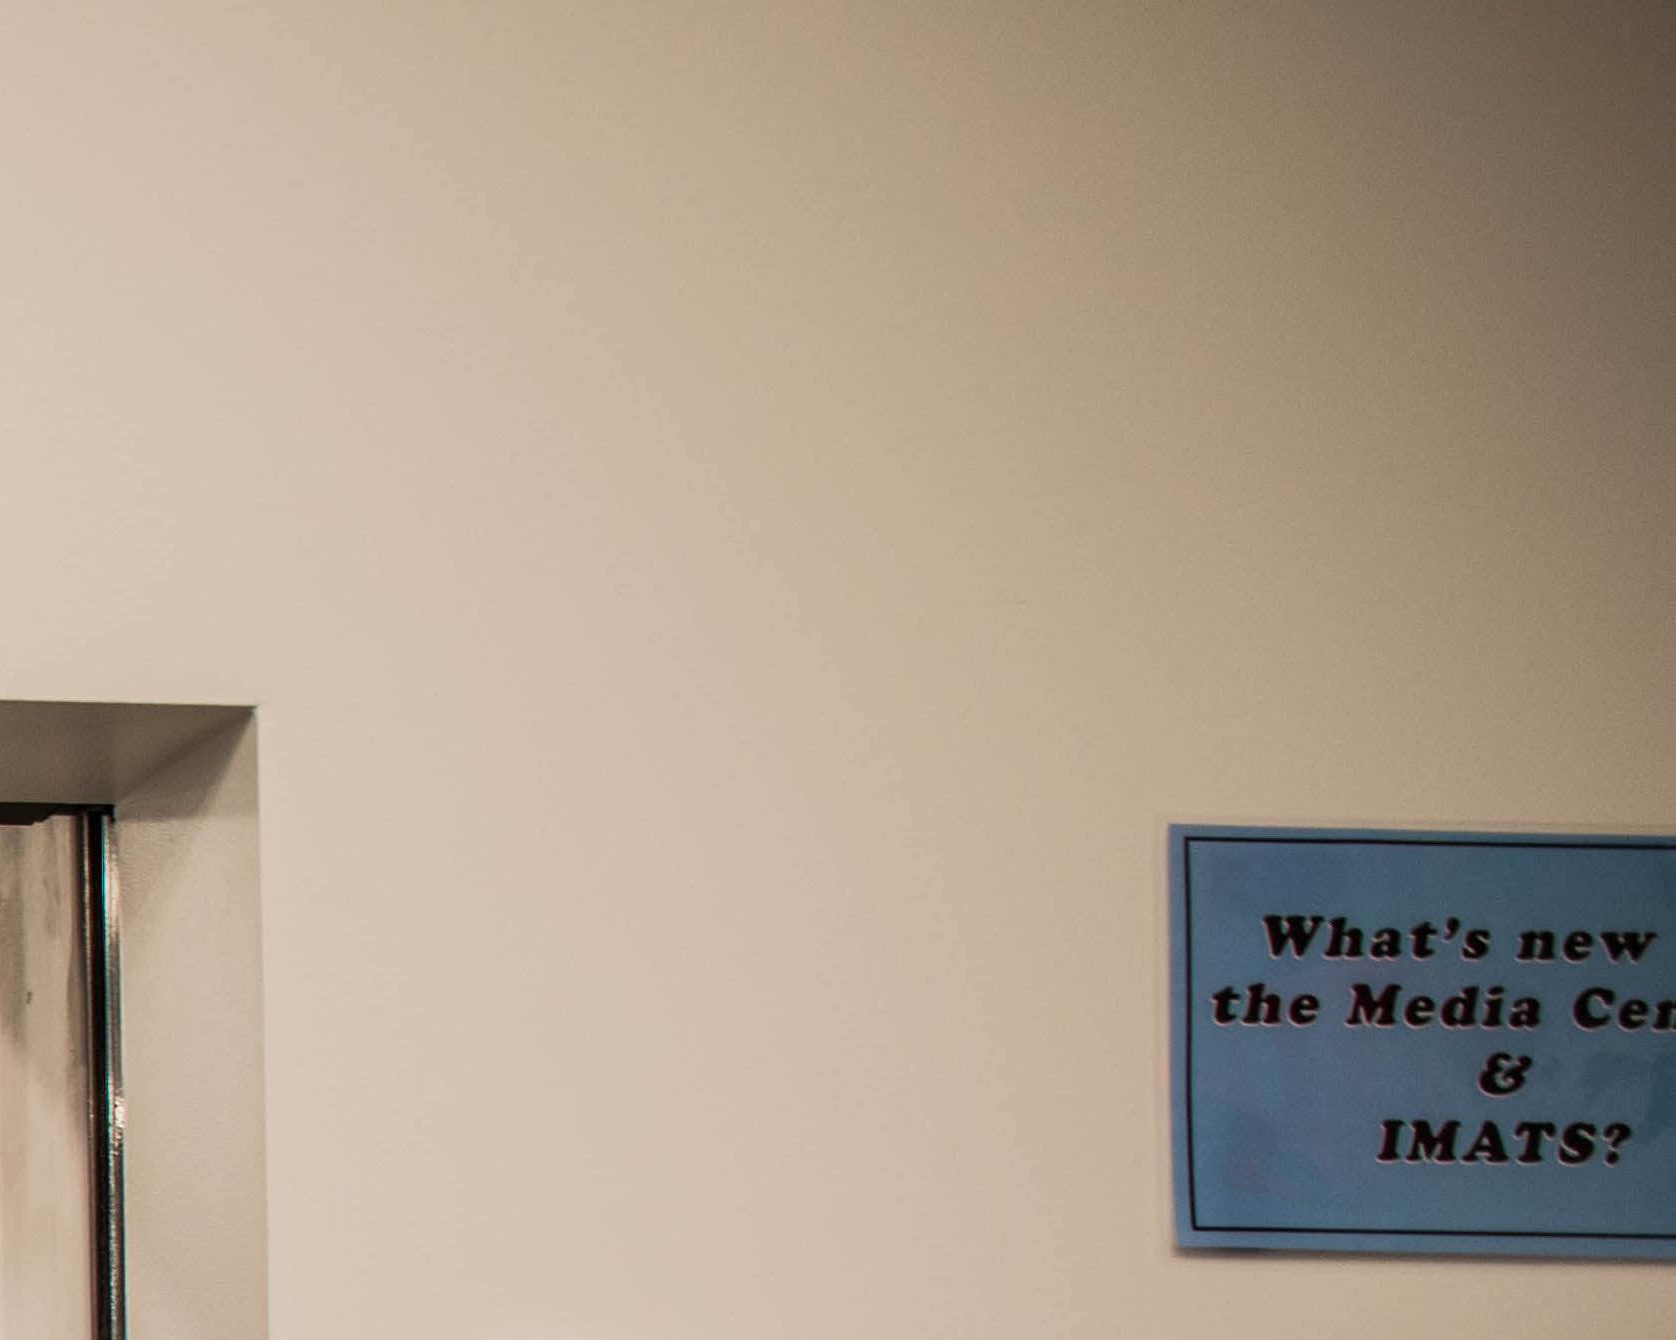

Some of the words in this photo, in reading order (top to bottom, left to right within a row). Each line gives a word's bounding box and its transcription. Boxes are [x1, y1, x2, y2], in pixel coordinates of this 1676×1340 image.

[1262, 915, 1491, 962] What's
[1517, 928, 1658, 964] new
[1209, 982, 1320, 1028] the
[1344, 984, 1542, 1030] Media
[1477, 1051, 1533, 1097] &
[1374, 1119, 1634, 1166] IMATS?
